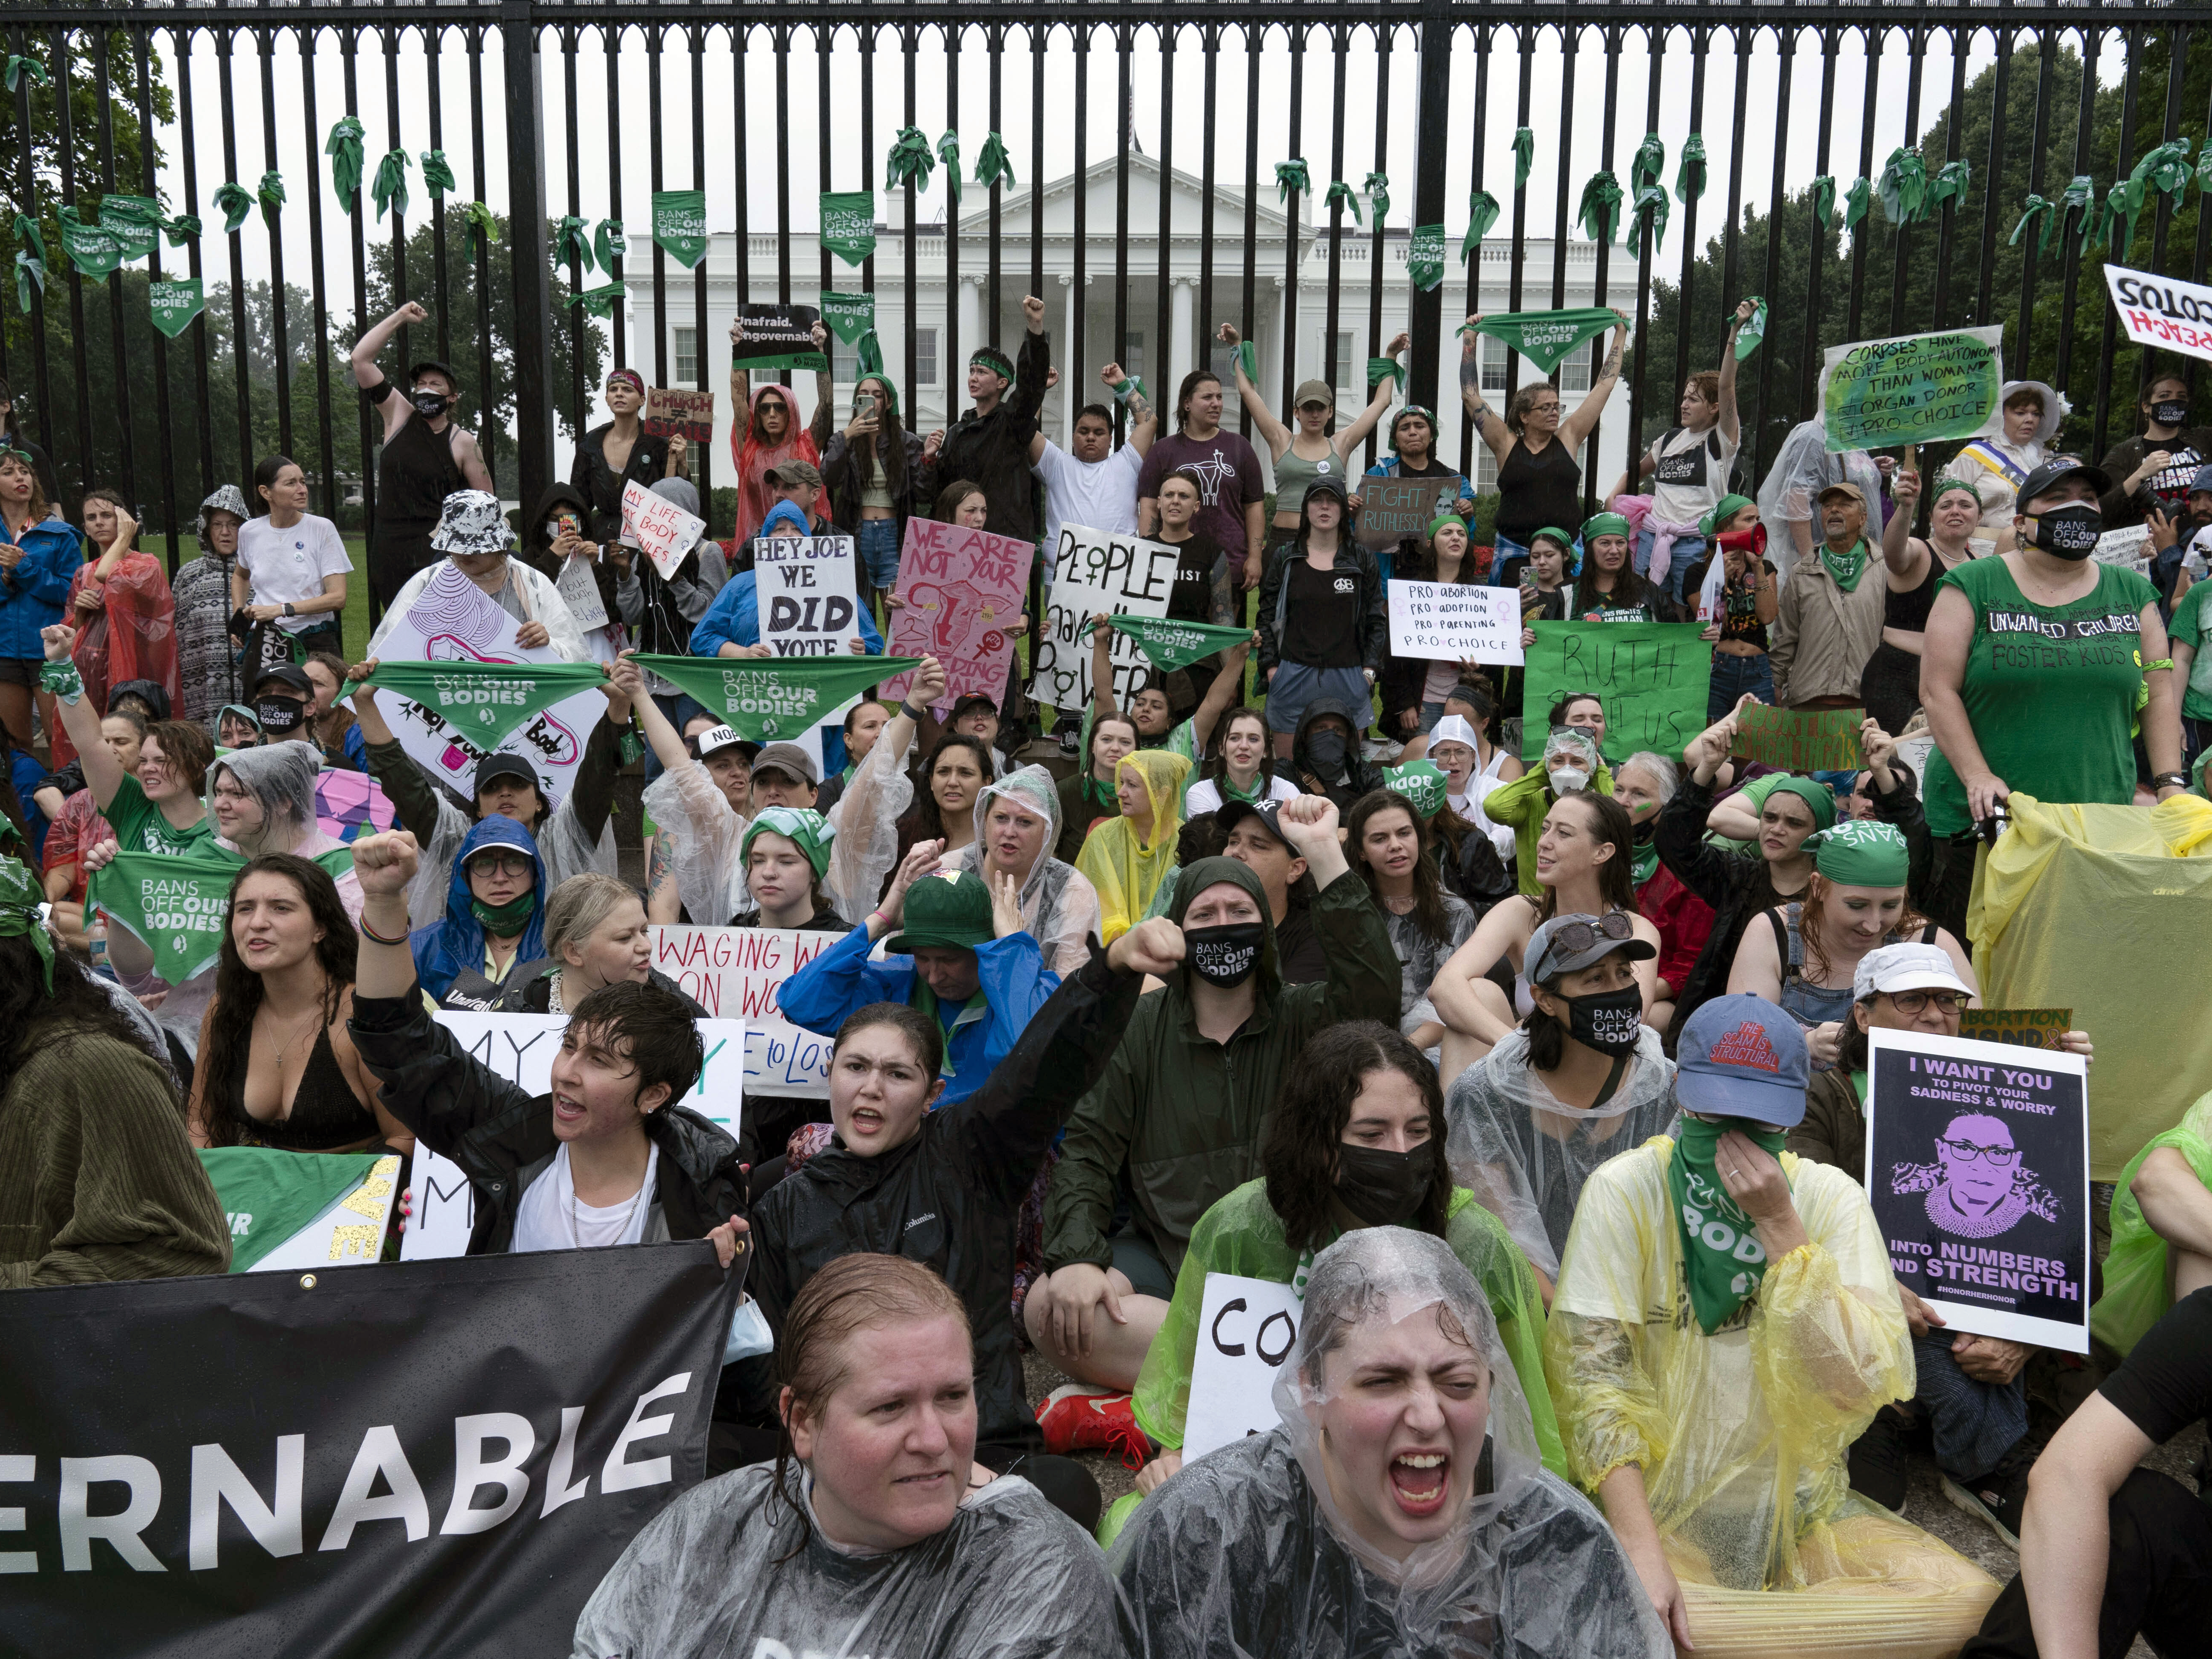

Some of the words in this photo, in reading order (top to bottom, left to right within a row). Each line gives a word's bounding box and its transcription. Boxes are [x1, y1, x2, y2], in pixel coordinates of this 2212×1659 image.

[103, 217, 135, 228] BANS
[657, 219, 682, 228] OFF
[658, 211, 691, 219] BANS
[825, 211, 858, 221] BANS
[125, 228, 153, 237] OUR
[660, 228, 706, 237] BODIES
[825, 220, 849, 230] OFF
[826, 228, 874, 239] BODIES
[73, 237, 95, 245] OFF
[165, 290, 194, 299] OUR
[825, 304, 870, 317] BODIES
[1521, 328, 1547, 337] OFF
[1549, 325, 1579, 334] OUR
[1523, 334, 1572, 347] BODIES
[1846, 339, 1917, 365] CORPSES
[1929, 335, 1964, 348] HAVE
[1836, 362, 1886, 384] MORE
[1895, 354, 1934, 371] BODY
[1870, 373, 1912, 393] THAN
[651, 390, 712, 412] CHURCH
[1861, 395, 1915, 415] ORGAN
[1924, 383, 1976, 401] DONOR
[650, 415, 711, 439] STATE
[1861, 401, 1987, 436] PRO-CHOICE
[1659, 469, 1692, 478] BODIES
[1676, 463, 1695, 471] OUR
[1367, 485, 1425, 508] FIGHT
[623, 506, 635, 520] MY
[625, 489, 645, 506] MY
[650, 502, 682, 526] LIFE.
[1364, 511, 1429, 532] RUTHLESSLY
[2056, 521, 2086, 531] BANS
[912, 520, 947, 549] WE
[959, 532, 1023, 564] ARE
[2053, 539, 2093, 549] BODIES
[2054, 530, 2077, 539] OFF
[2078, 531, 2096, 541] OUR
[755, 537, 803, 561] HEY
[805, 536, 848, 559] JOE
[1828, 554, 1848, 567] OFF
[779, 565, 816, 588] WE
[907, 548, 955, 578] NOT
[968, 554, 1020, 595] YOUR
[566, 577, 587, 590] but
[1409, 586, 1433, 598] PRO
[768, 595, 853, 632] DID
[1411, 604, 1430, 615] PRO
[2007, 602, 2025, 611] me
[2067, 604, 2110, 620] happens
[2114, 601, 2132, 612] to
[1143, 624, 1171, 634] OFF
[1172, 629, 1206, 643] OUR
[1415, 620, 1432, 629] PRO
[1990, 612, 2066, 638] UNWANED
[2078, 615, 2140, 636] CHILDREN
[772, 639, 838, 657] VOTE
[1144, 632, 1197, 650] BODIES
[1404, 635, 1439, 646] PRO
[1448, 638, 1507, 650] CHOICE
[2030, 637, 2041, 645] I
[2093, 635, 2121, 643] with
[1563, 634, 1679, 689] RUTH
[1993, 644, 2072, 670] FOSTER
[2079, 645, 2125, 667] KIDS
[434, 681, 478, 691] OFF
[482, 680, 536, 692] OUR
[722, 671, 779, 686] BANS
[438, 690, 527, 705] BODIES
[724, 683, 764, 697] OFF
[767, 686, 817, 702] OUR
[727, 699, 807, 716] BODIES
[1645, 710, 1681, 748] US
[1737, 703, 1864, 737] ABORTION
[712, 730, 742, 742] NOP
[1752, 729, 1869, 771] HEALTHCARE
[1843, 828, 1906, 848] BANS
[142, 879, 198, 896] BANS
[142, 896, 181, 912] OFF
[145, 912, 222, 932] BODIES
[659, 928, 780, 971] WAGING
[1196, 942, 1232, 954] BANS
[1196, 954, 1222, 965] OFF
[1224, 946, 1254, 963] OUR
[1199, 958, 1249, 976] BODIES
[679, 971, 720, 1016] ON
[1593, 1021, 1623, 1031] OFF
[1626, 1010, 1641, 1029] OUR
[1594, 1007, 1633, 1020] BANS
[1739, 1022, 1761, 1034] THE
[1721, 1032, 1755, 1047] SCAM
[1755, 1036, 1768, 1050] IS
[768, 1039, 784, 1068] to
[1710, 1045, 1777, 1067] STRUCTURAL
[1910, 1057, 1916, 1072] I
[1924, 1059, 1994, 1082] WANT
[2001, 1070, 2052, 1090] YOU
[1932, 1078, 1949, 1088] TO
[1953, 1081, 1990, 1094] PIVOT
[1994, 1086, 2030, 1100] YOUR
[1910, 1086, 1980, 1104] SADNESS
[1986, 1097, 1997, 1107] &
[2001, 1099, 2056, 1115] WORRY
[904, 1213, 935, 1230] Columbia
[1891, 1240, 1932, 1256] INTO
[1941, 1242, 2065, 1278] NUMBERS
[1926, 1259, 2077, 1301] STRENGTH
[1937, 1286, 2016, 1304] #HONORHERHONOR
[0, 1372, 692, 1574] ERNABLE
